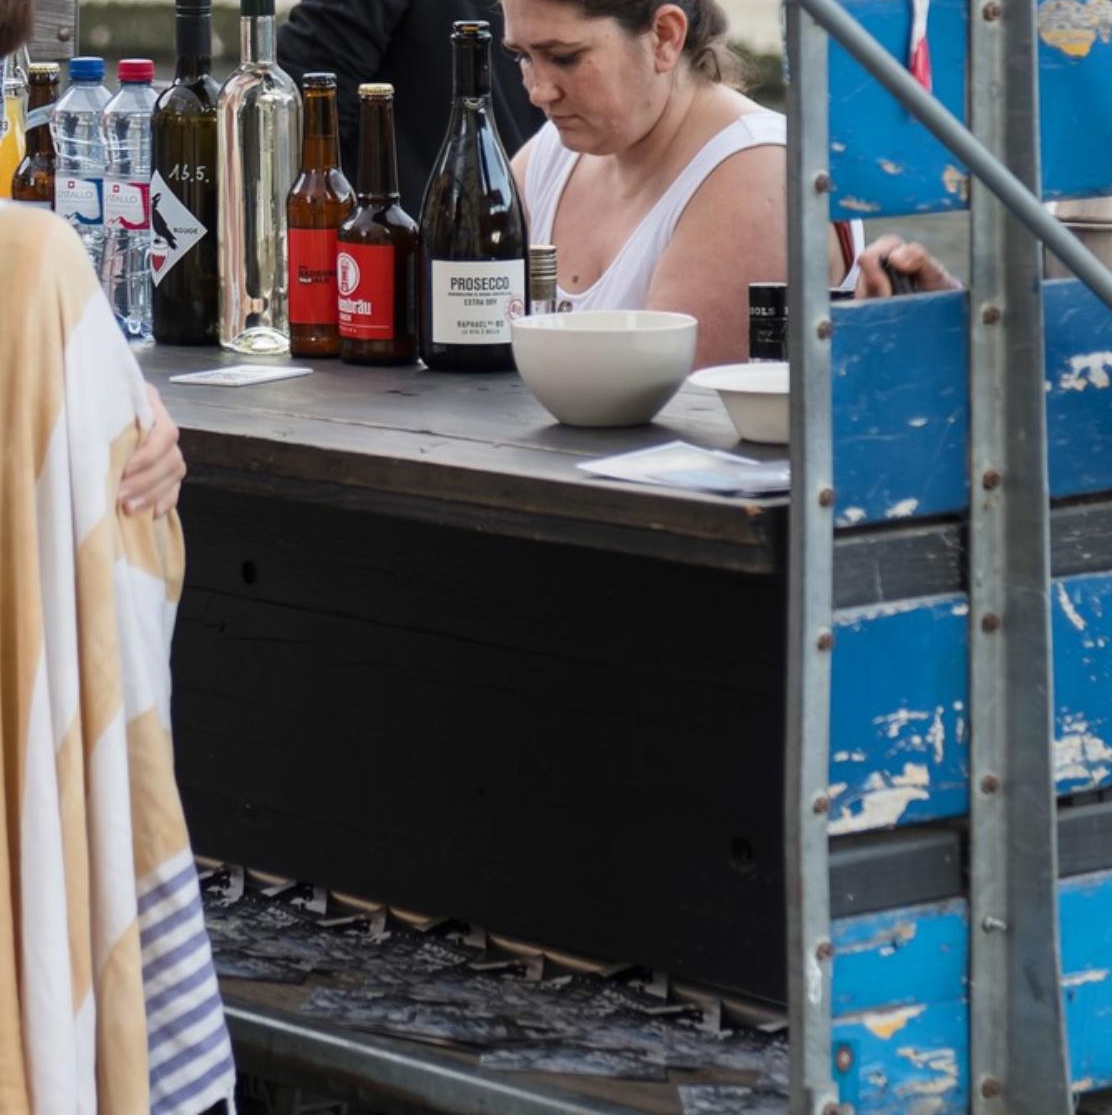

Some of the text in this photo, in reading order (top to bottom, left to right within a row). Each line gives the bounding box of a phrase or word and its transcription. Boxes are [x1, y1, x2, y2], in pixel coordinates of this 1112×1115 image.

[450, 276, 510, 291] PROSECCO
[464, 298, 498, 306] EXTRA DRY
[457, 320, 487, 328] RAPHAEL
